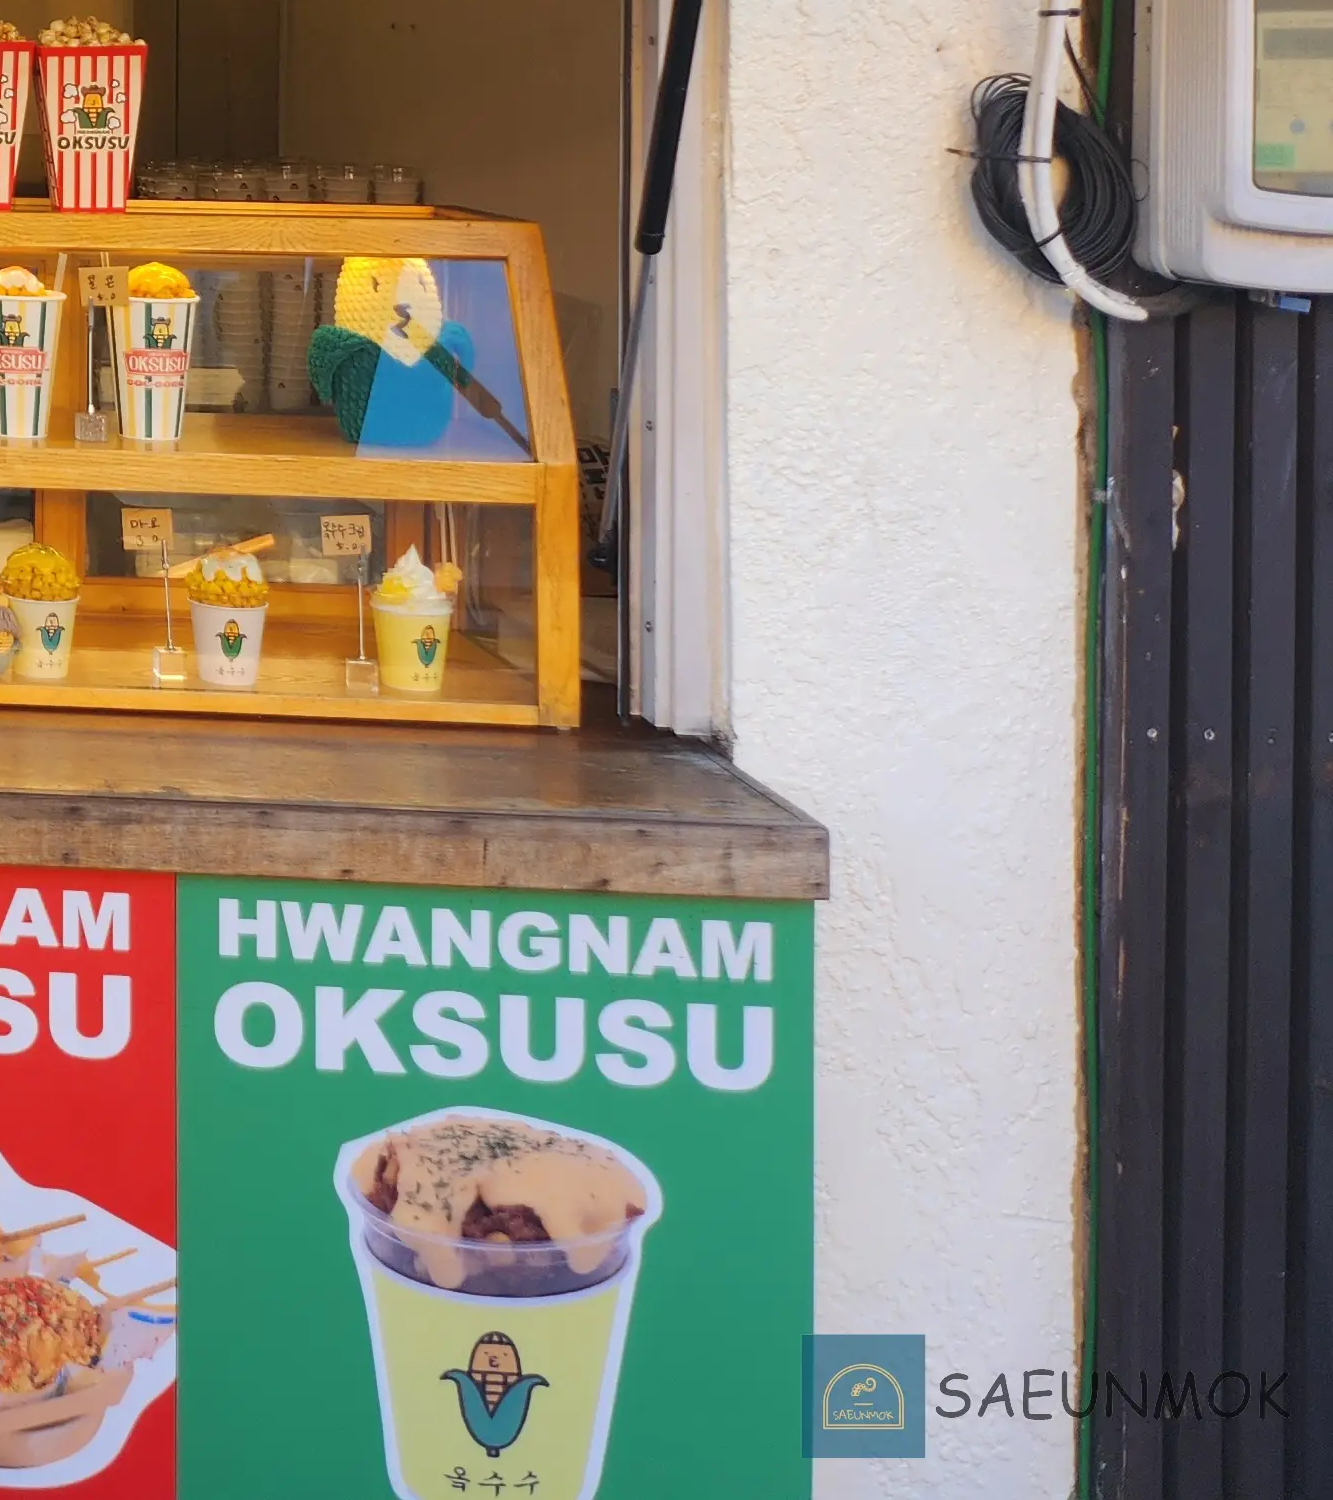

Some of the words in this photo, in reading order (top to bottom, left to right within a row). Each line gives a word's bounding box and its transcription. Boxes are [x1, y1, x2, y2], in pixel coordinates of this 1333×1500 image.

[57, 134, 130, 150] OKSUSU
[129, 355, 187, 372] OKSUSU
[218, 898, 773, 981] HWANGNAM
[214, 981, 774, 1092] OKSUSU
[443, 1465, 541, 1496] 옥수수
